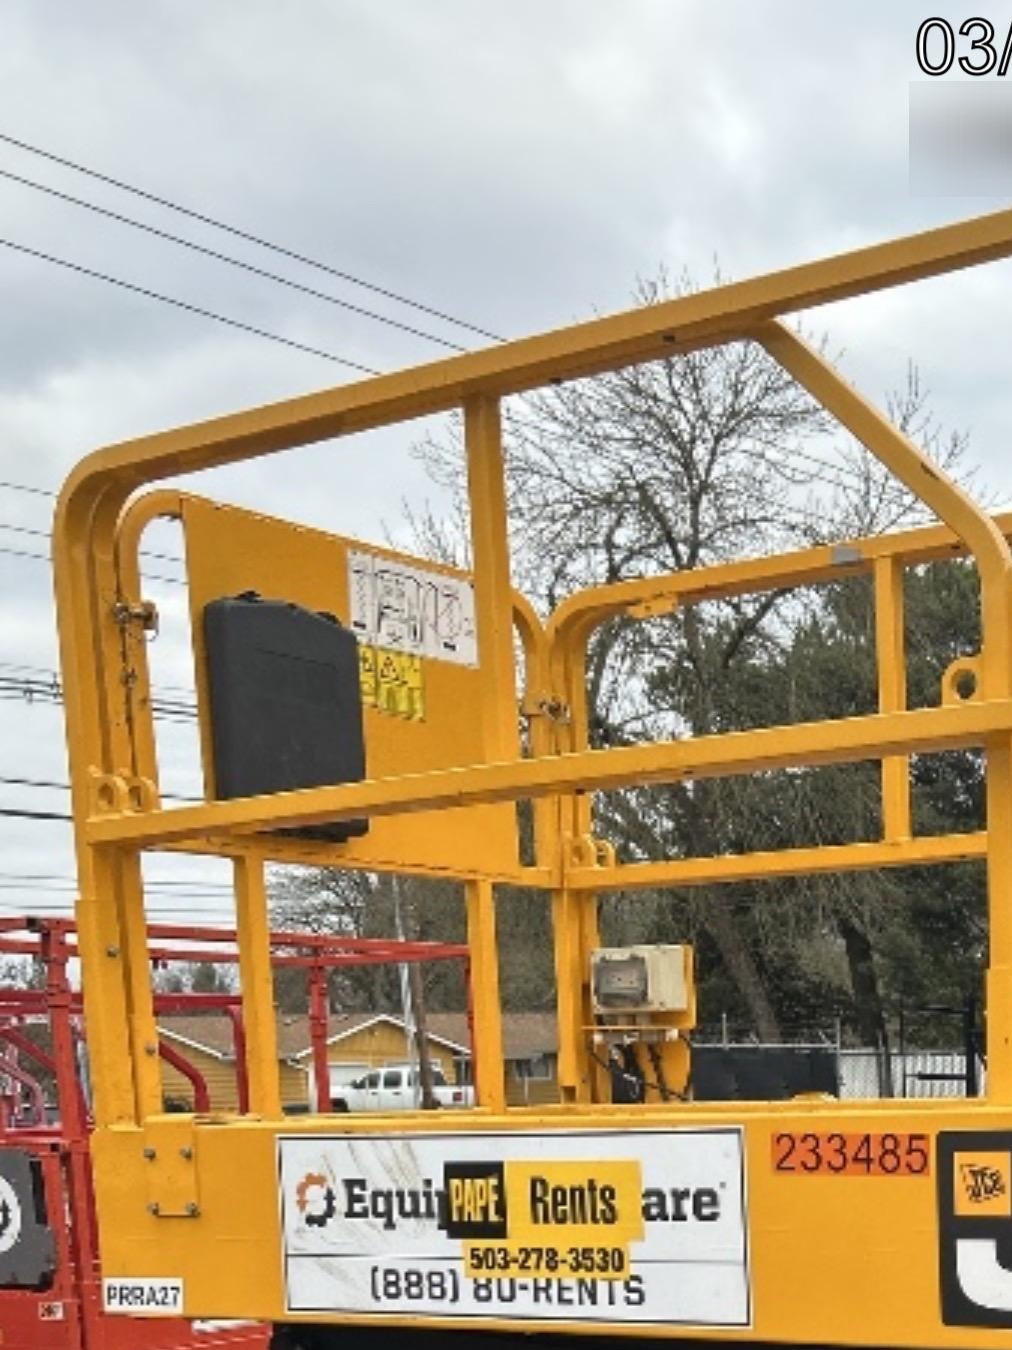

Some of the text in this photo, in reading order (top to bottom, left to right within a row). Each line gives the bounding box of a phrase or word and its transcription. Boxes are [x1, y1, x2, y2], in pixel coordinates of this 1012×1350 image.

[775, 1134, 928, 1173] 233485
[531, 1173, 617, 1225] Rents
[470, 1247, 625, 1272] 503-278-3530
[107, 1285, 180, 1306] PRRA27
[371, 1266, 460, 1303] (888)
